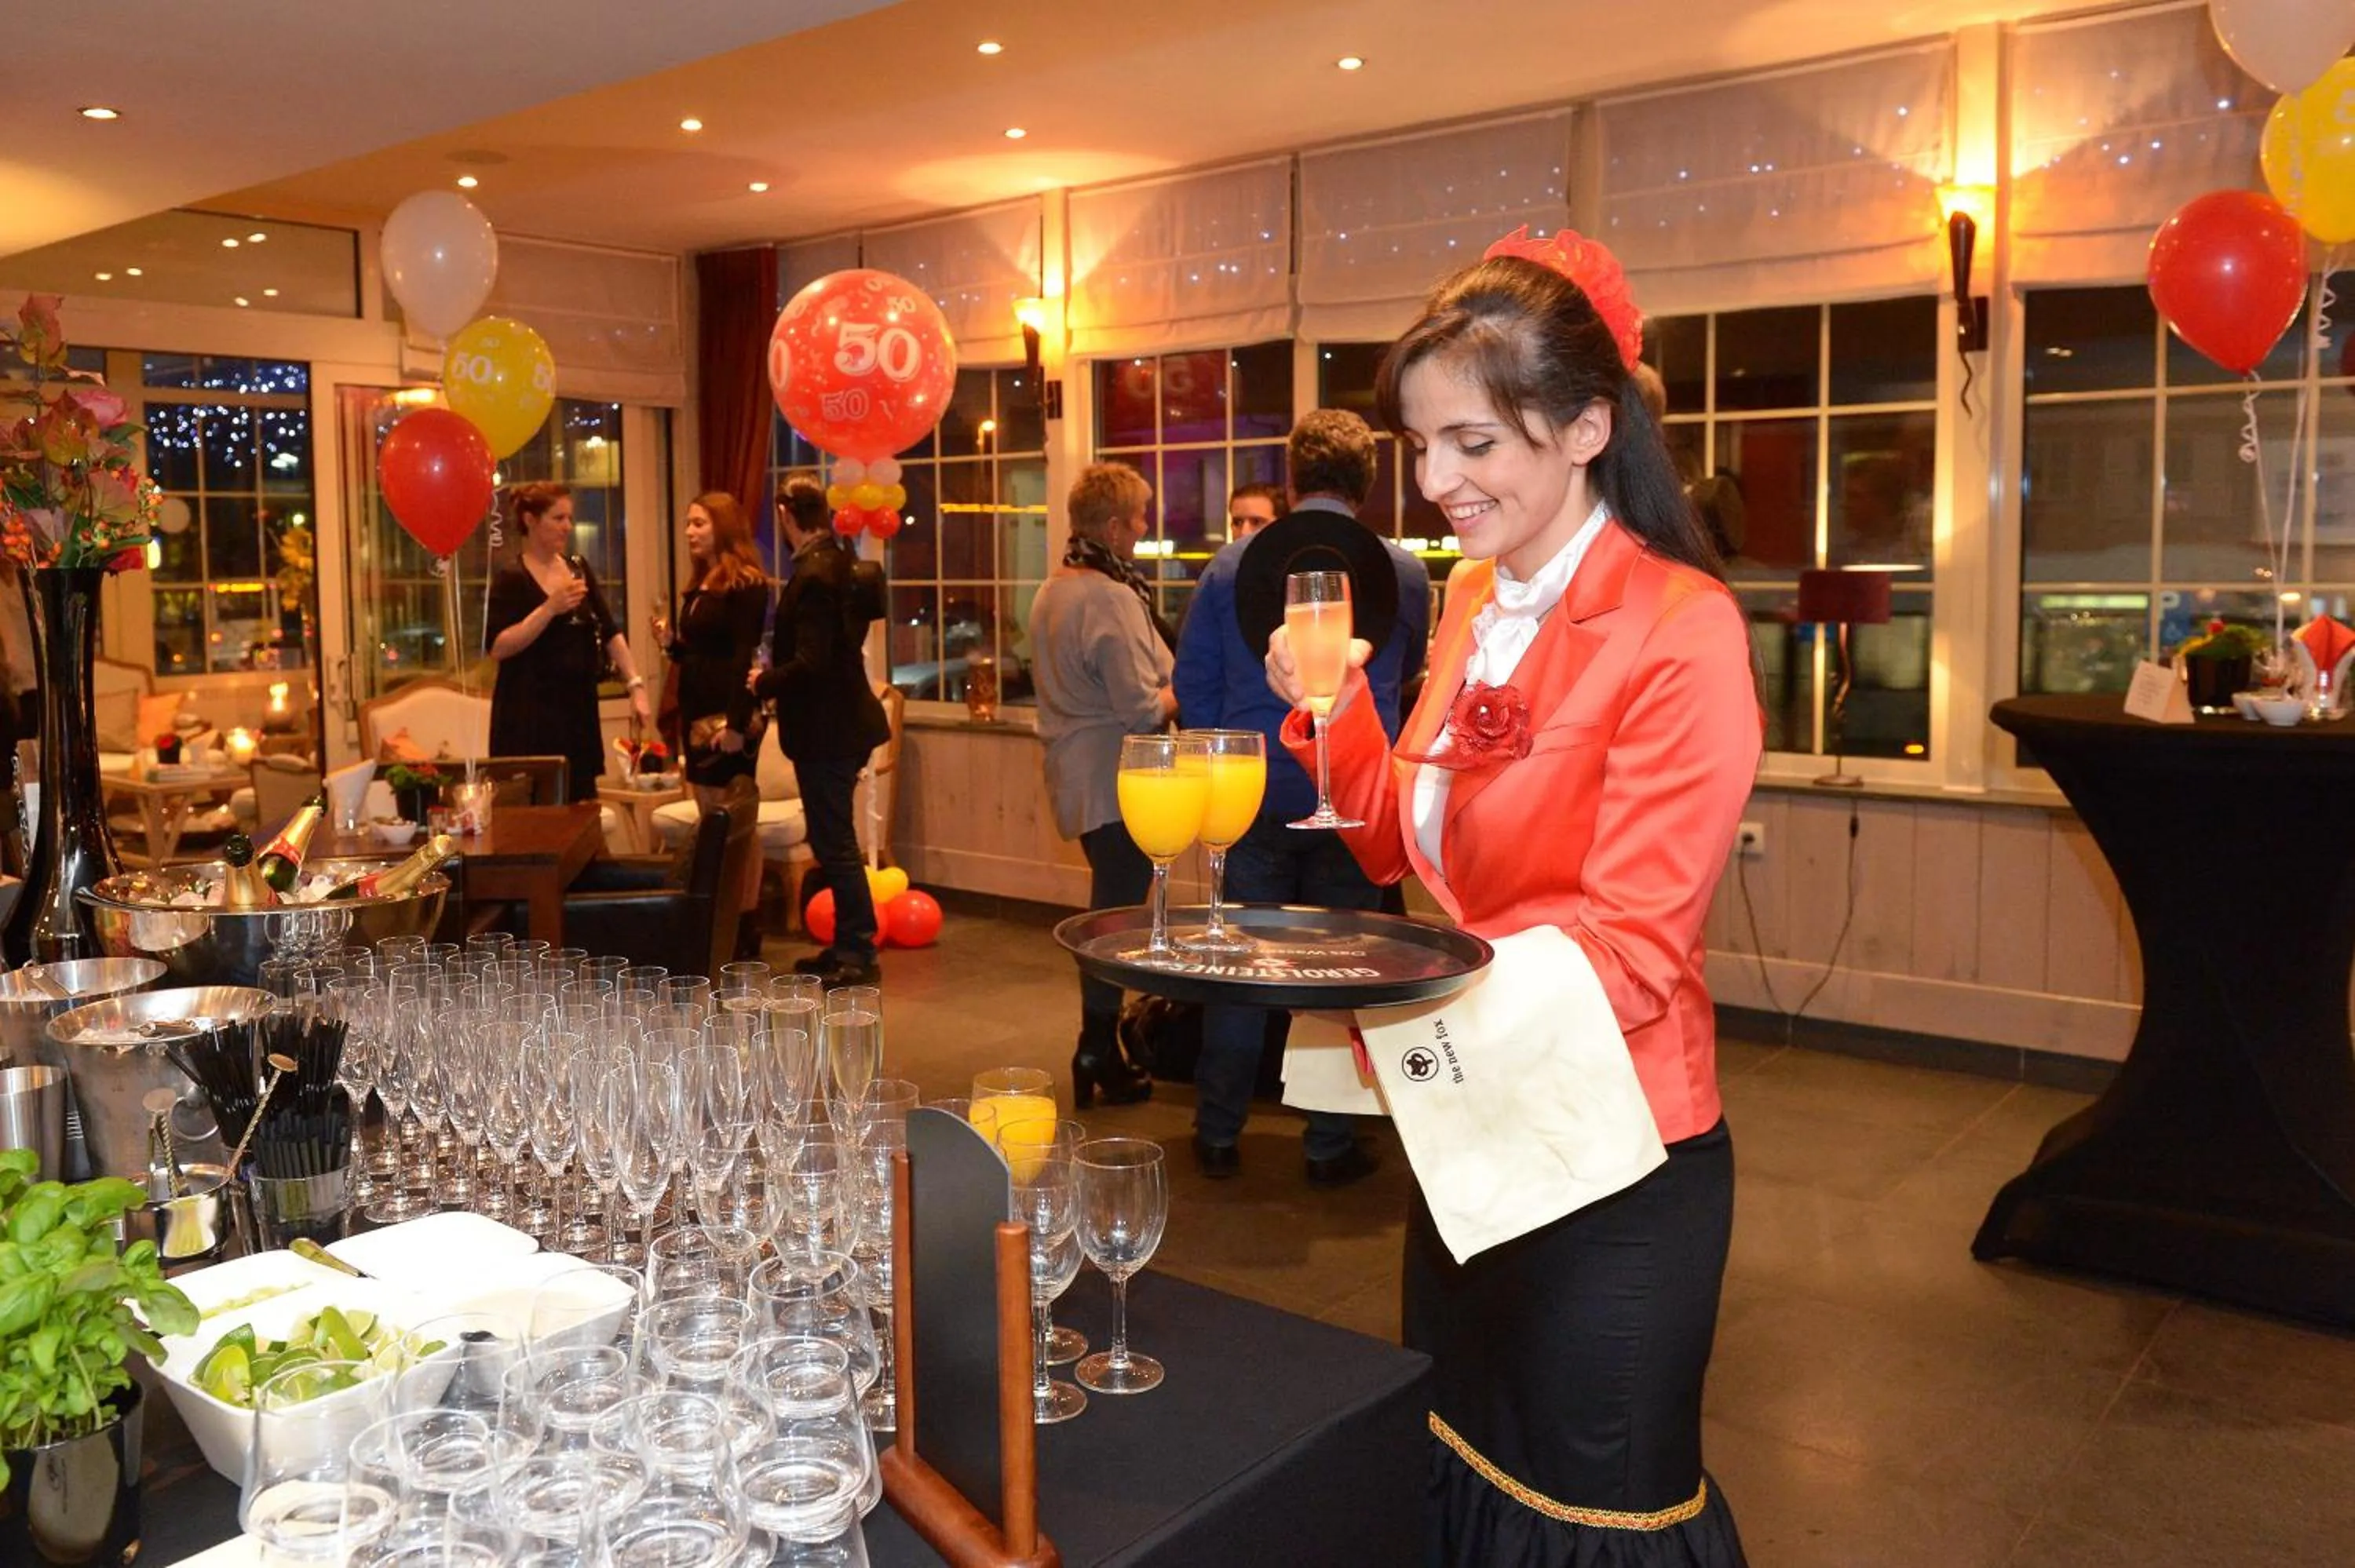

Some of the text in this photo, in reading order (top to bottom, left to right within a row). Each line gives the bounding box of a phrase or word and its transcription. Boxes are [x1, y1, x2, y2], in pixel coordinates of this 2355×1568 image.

[834, 322, 922, 383] 50
[820, 388, 869, 421] 50
[1433, 1019, 1464, 1084] the new fox
